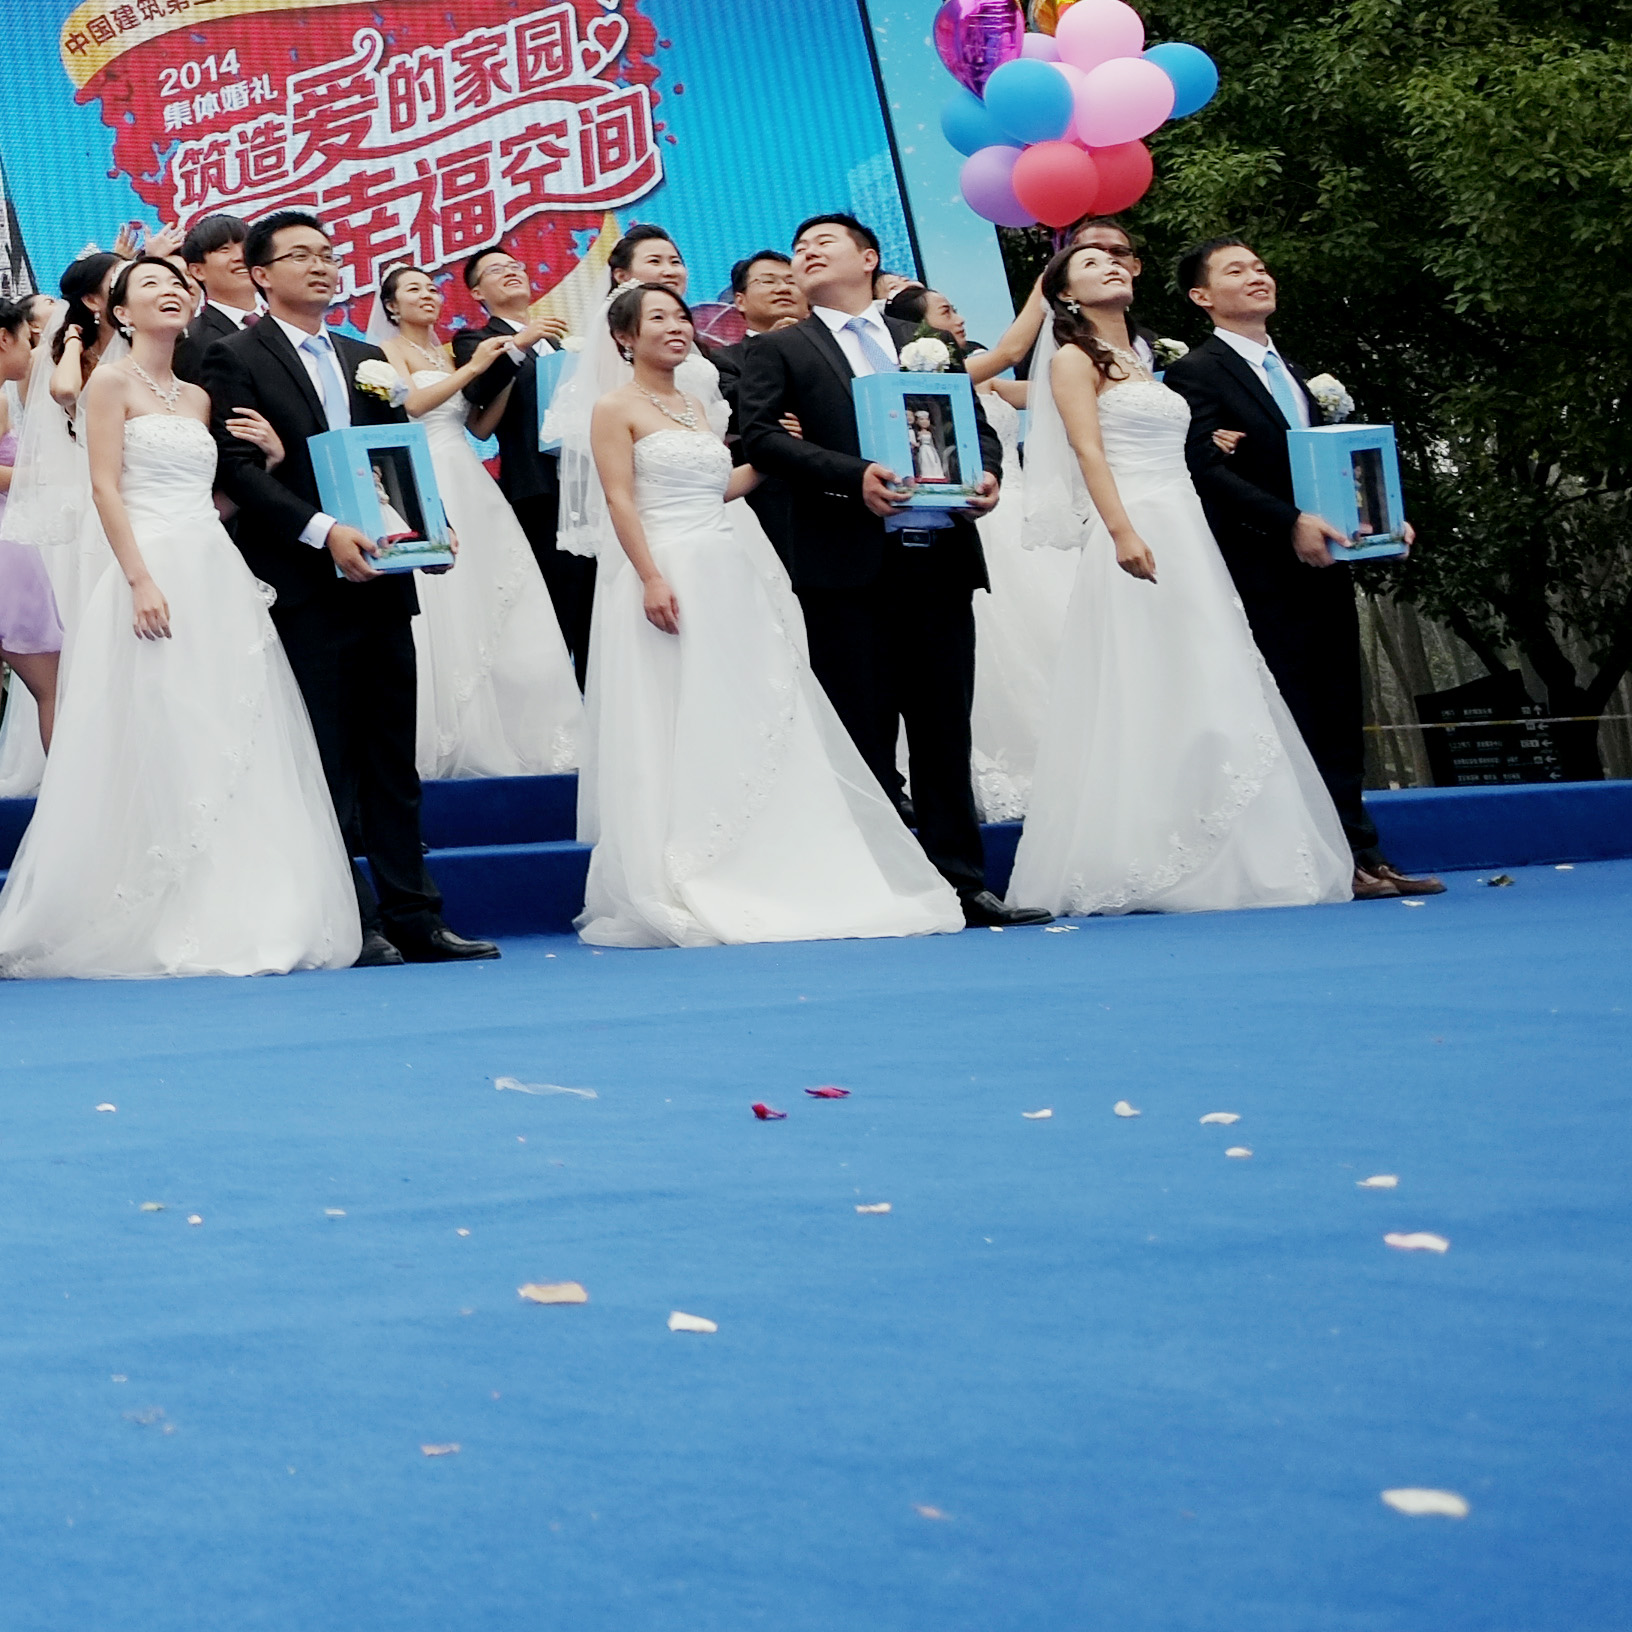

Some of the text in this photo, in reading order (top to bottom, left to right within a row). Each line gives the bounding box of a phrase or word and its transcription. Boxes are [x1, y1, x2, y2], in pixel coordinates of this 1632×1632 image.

[158, 48, 241, 98] 2014
[163, 72, 279, 134] 集体婚礼
